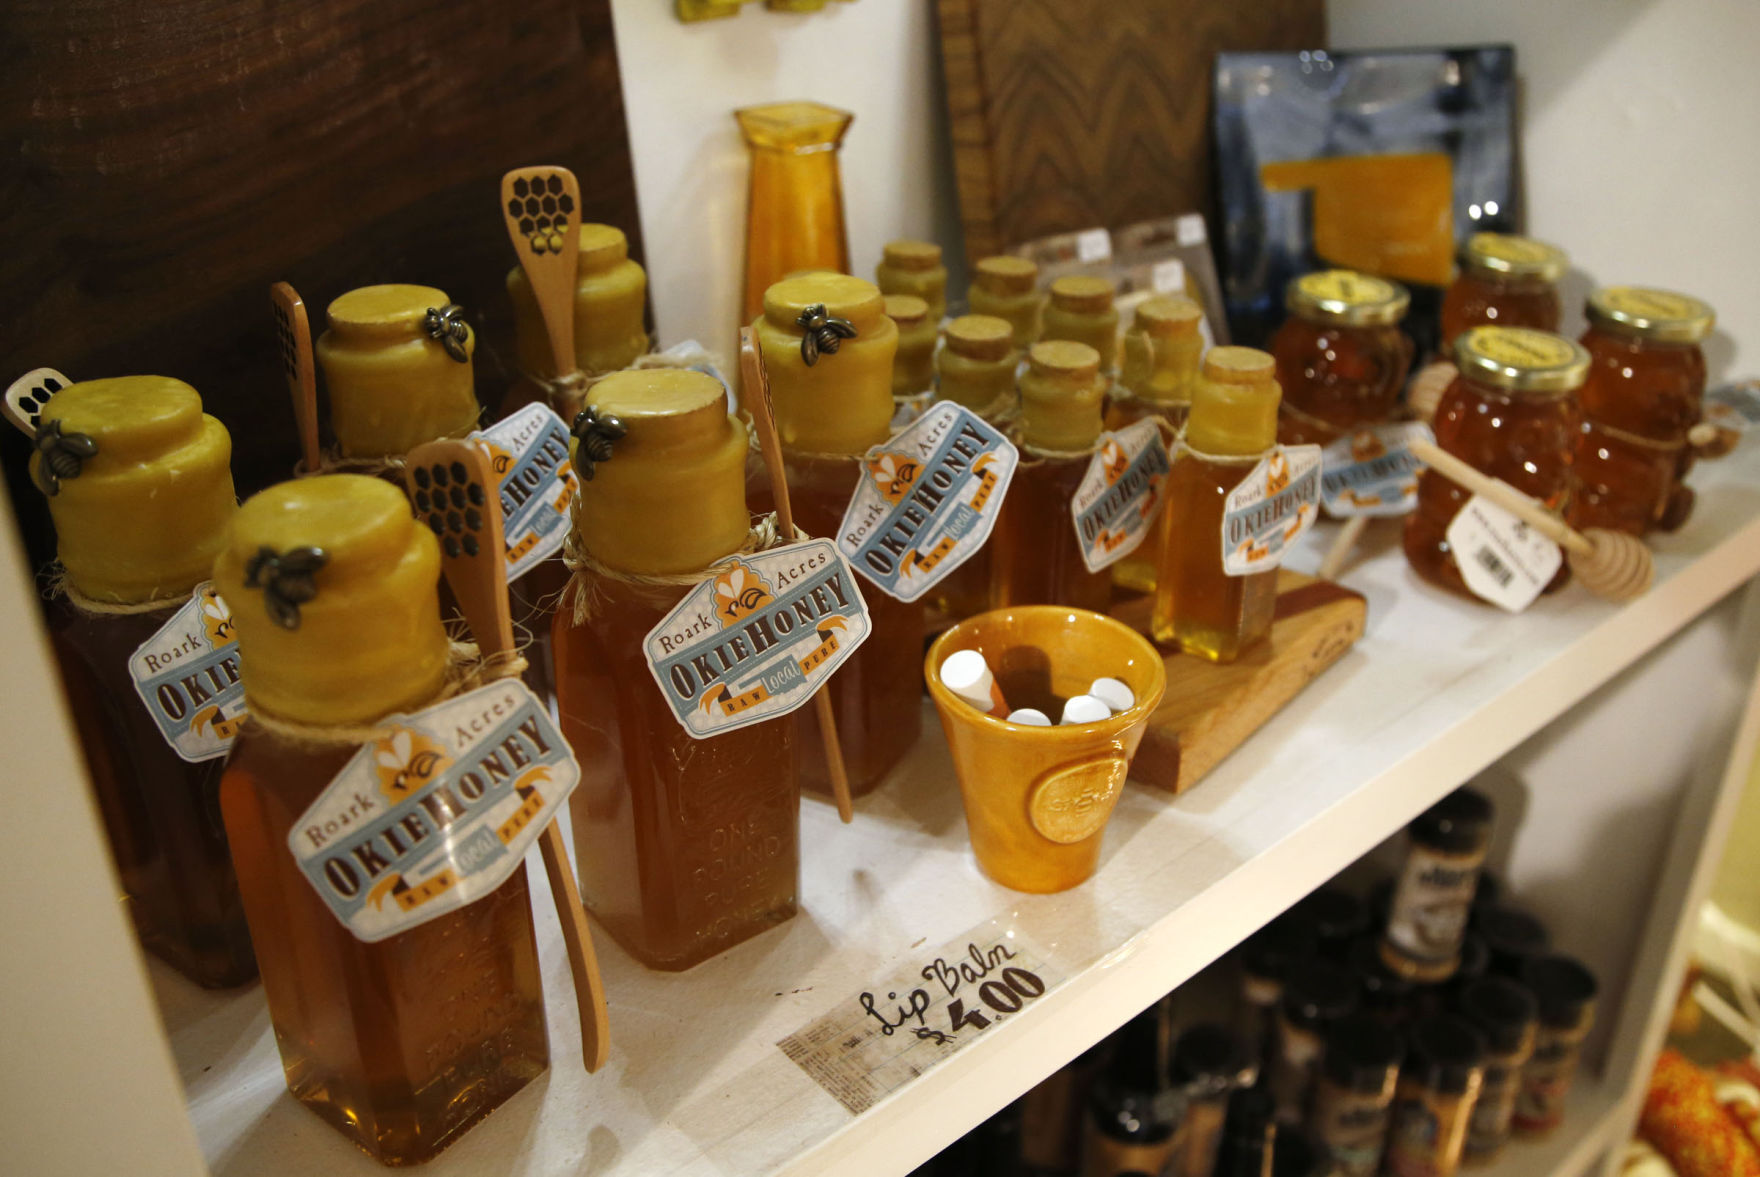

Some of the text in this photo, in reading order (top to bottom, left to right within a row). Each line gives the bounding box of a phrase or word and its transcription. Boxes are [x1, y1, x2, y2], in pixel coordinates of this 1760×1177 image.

[511, 414, 544, 452] Acres
[846, 413, 953, 548] Roark Acres
[658, 550, 827, 655] Roark Acres
[669, 571, 850, 700] OKIEHONEY
[143, 633, 202, 675] Roark
[726, 691, 761, 713] RAW
[803, 639, 838, 671] PURE
[304, 691, 518, 850] Roark Acres
[859, 942, 1017, 1036] Lip Balm
